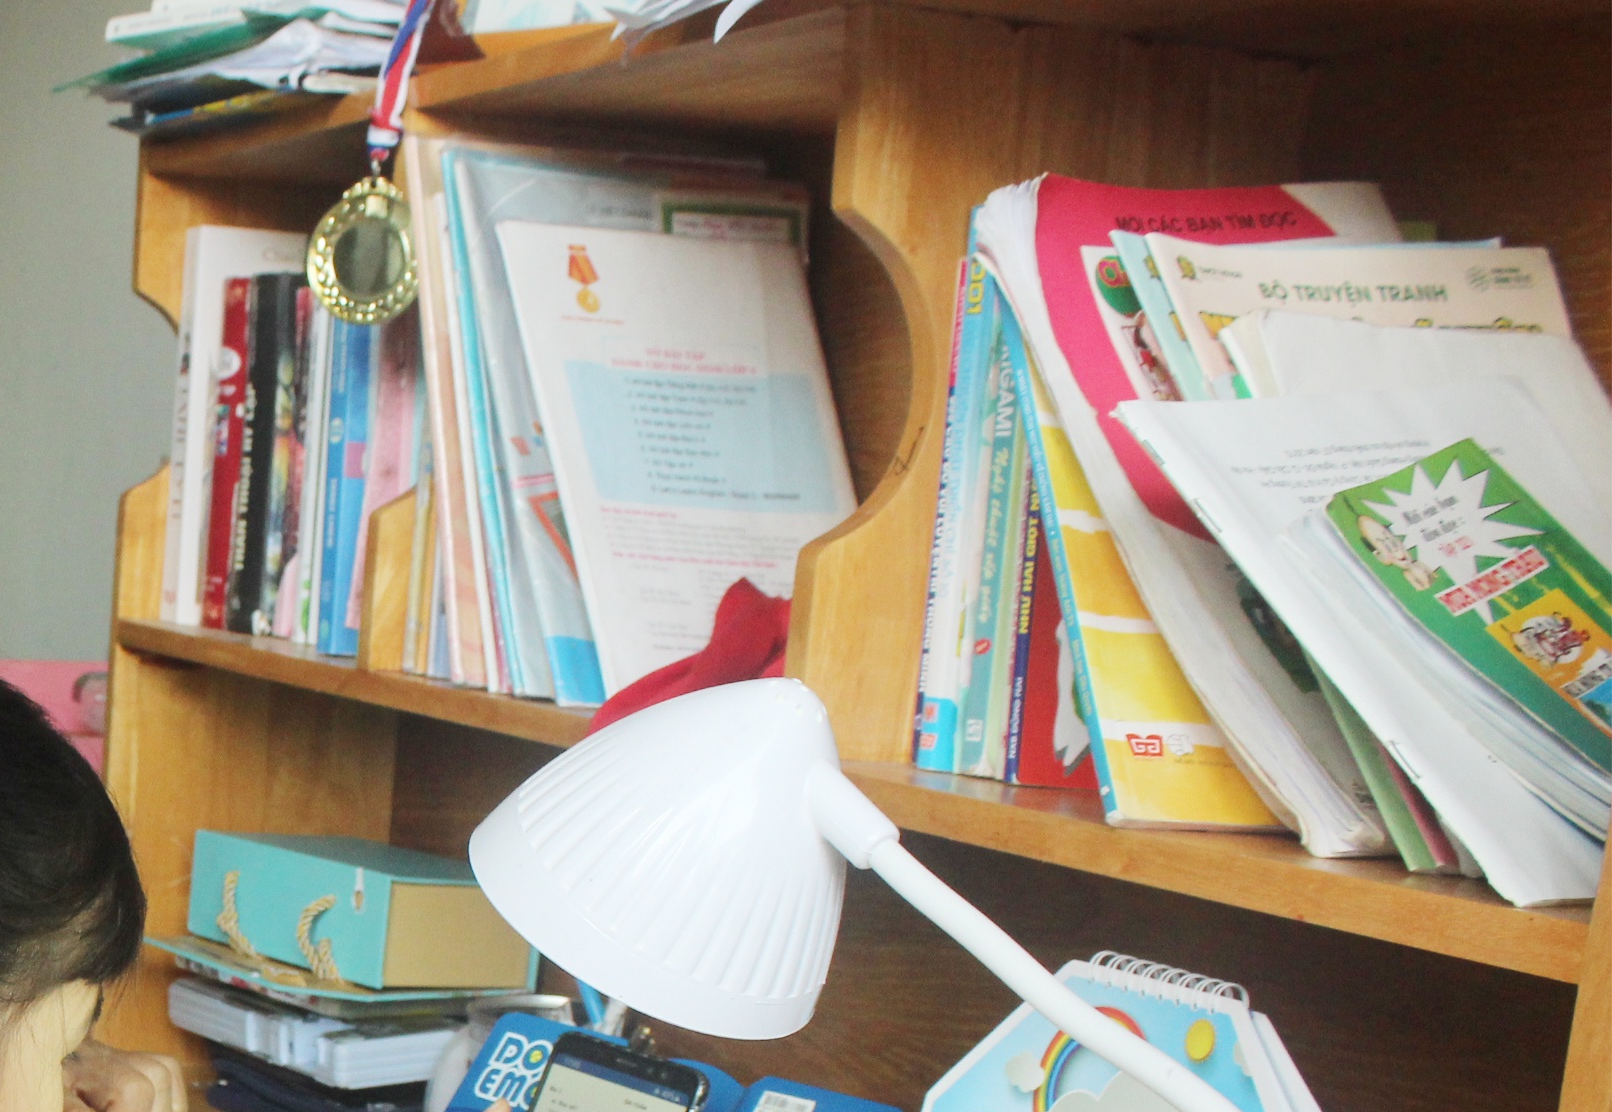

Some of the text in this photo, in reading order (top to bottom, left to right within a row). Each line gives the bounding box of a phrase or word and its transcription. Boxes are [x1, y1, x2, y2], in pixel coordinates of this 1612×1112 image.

[1292, 279, 1372, 306] TRUYỆN
[1376, 283, 1448, 302] TRANH
[1025, 515, 1041, 559] GIỌT
[1022, 558, 1038, 594] HAI
[1018, 596, 1034, 635] NHƯ
[1007, 735, 1018, 759] NXB
[1013, 676, 1024, 701] NAI
